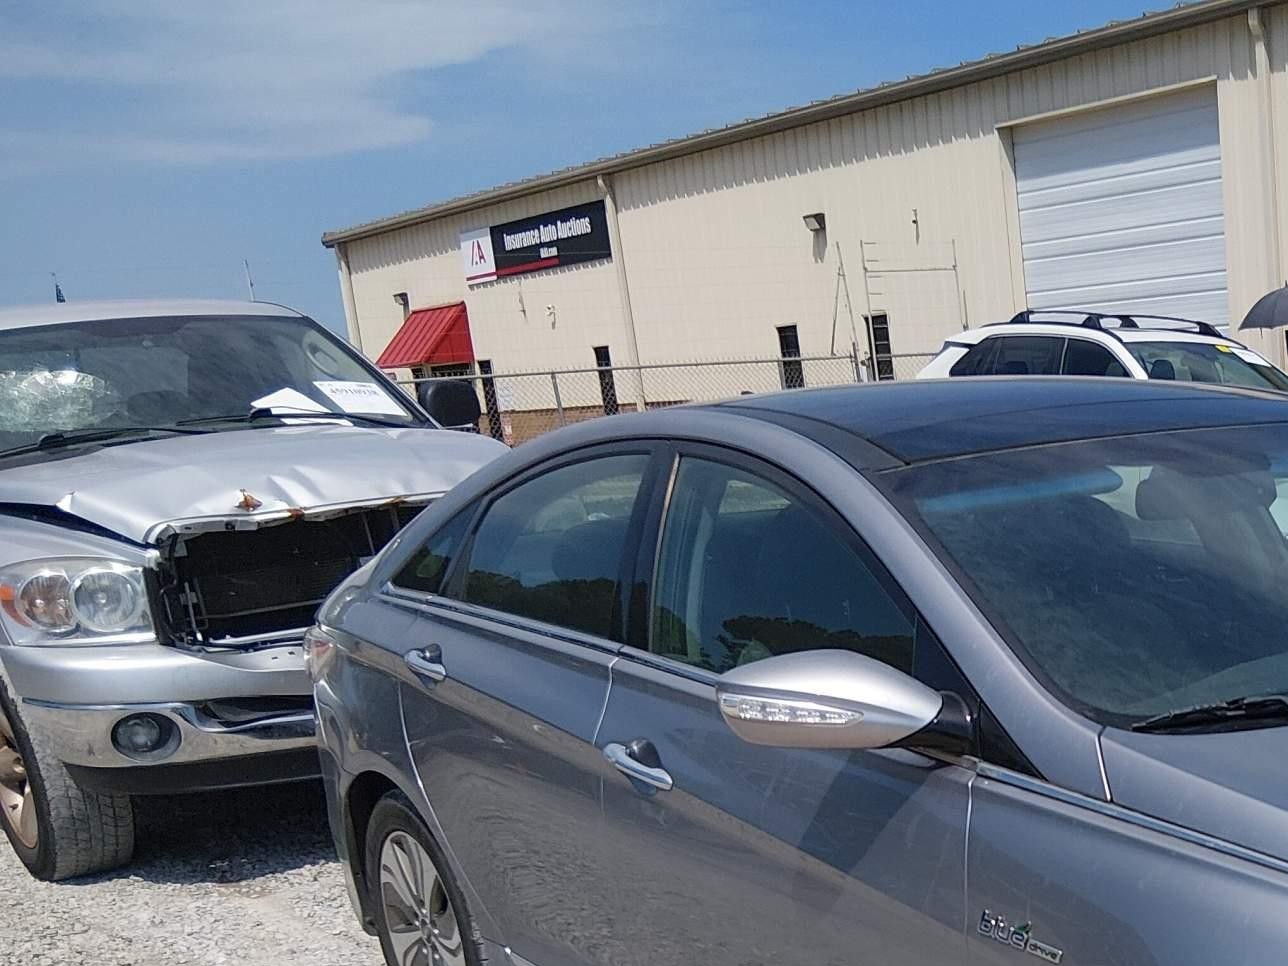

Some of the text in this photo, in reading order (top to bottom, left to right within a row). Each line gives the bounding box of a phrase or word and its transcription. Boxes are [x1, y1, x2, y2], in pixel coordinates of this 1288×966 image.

[503, 216, 592, 251] Insurance Auto Auctions
